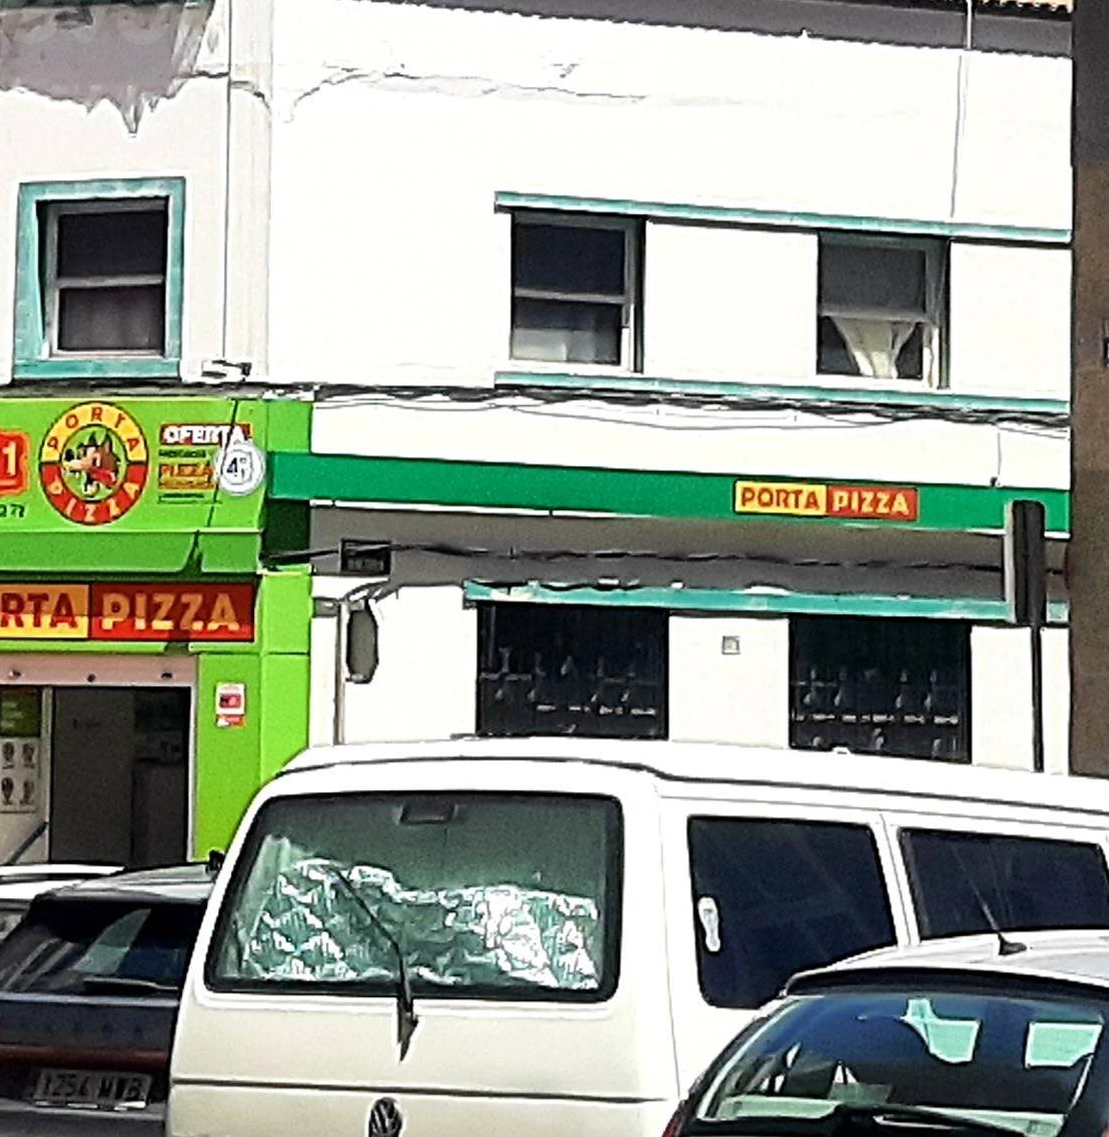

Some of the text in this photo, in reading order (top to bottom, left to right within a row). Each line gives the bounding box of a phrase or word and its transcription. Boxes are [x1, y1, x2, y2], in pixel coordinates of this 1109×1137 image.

[46, 406, 140, 452] PORTA
[46, 475, 140, 522] PIZZA
[742, 486, 911, 516] PORTA PIZZA
[100, 592, 242, 631] PIZZA
